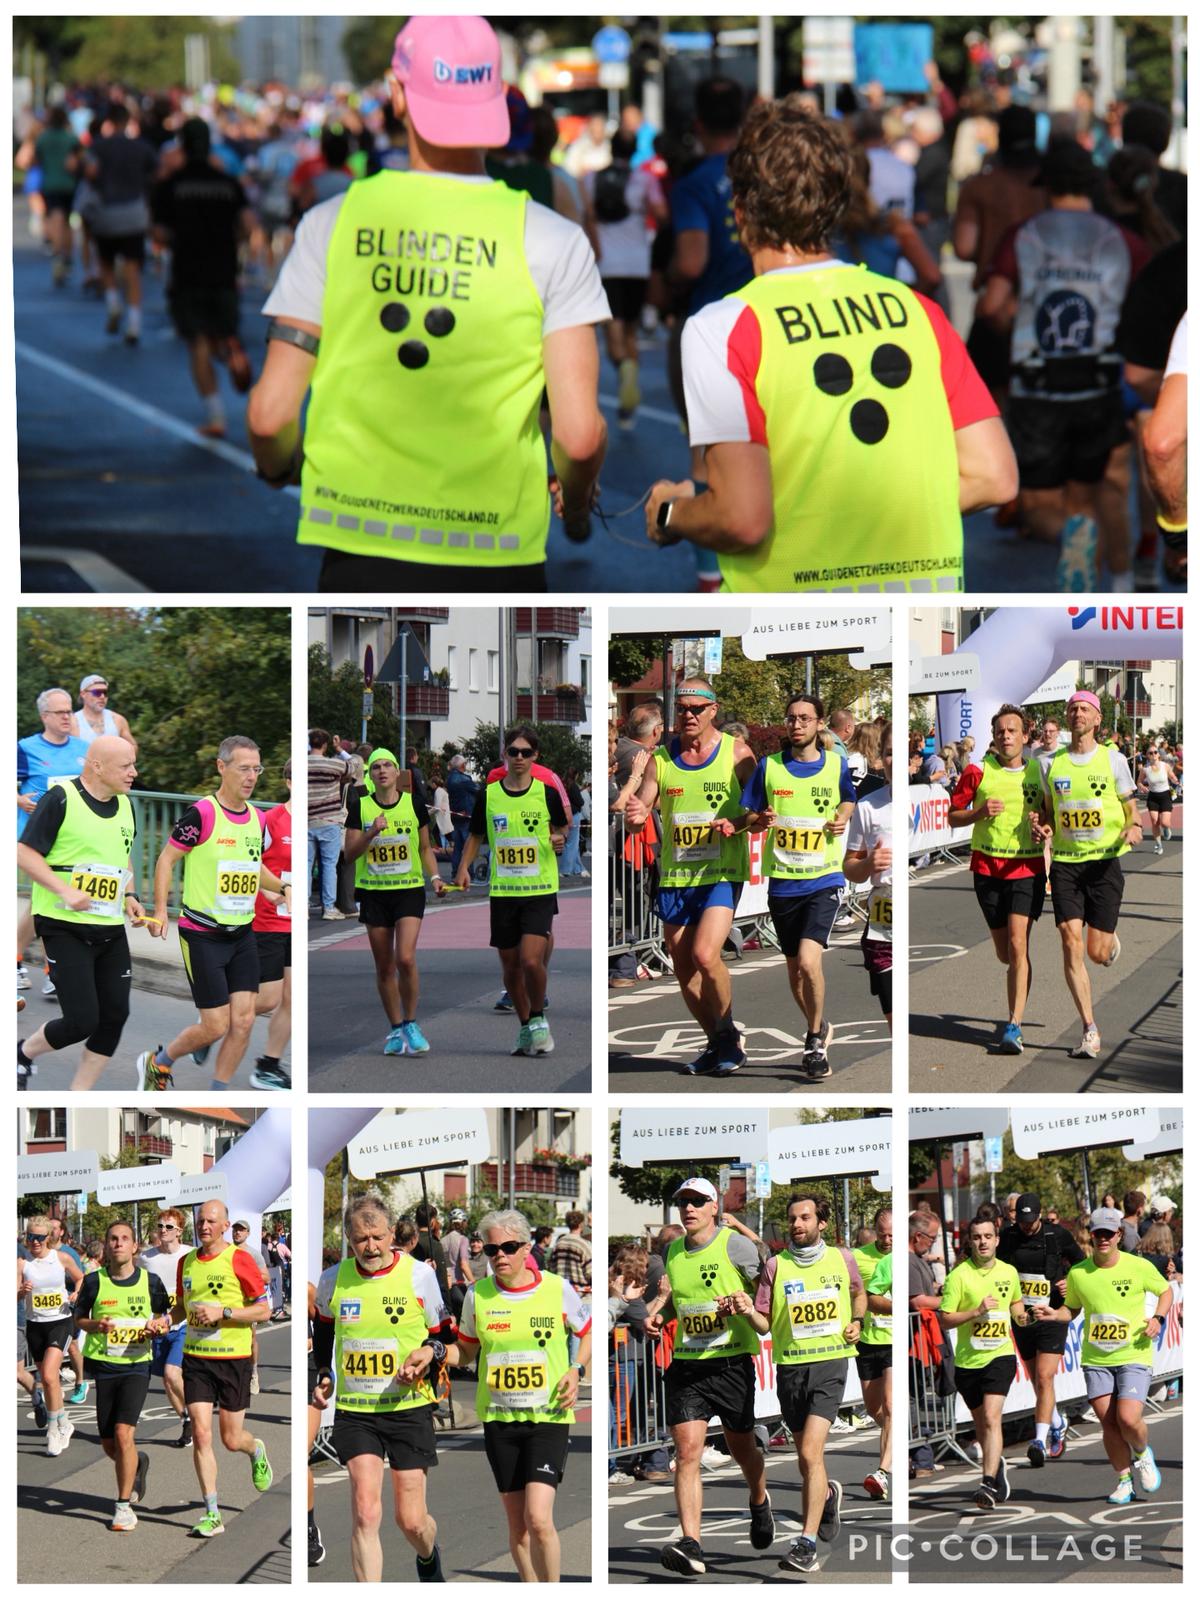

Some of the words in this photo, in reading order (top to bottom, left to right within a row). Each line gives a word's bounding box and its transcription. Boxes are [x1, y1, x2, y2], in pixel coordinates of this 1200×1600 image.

[356, 228, 497, 268] BLINDEN
[371, 263, 472, 301] GUIDE
[775, 292, 908, 345] BLIND
[315, 486, 500, 525] WWW.GUIDENETZWERKDEUTSCHLAND.DE
[753, 625, 774, 634] AUS
[779, 622, 811, 632] LIEBE
[816, 619, 838, 629] ZUM
[843, 616, 878, 626] SPORT
[1101, 607, 1183, 630] INTE
[960, 700, 972, 738] PORT
[704, 782, 726, 792] GUIDE
[811, 787, 832, 797] BLIND
[1062, 811, 1101, 827] 3123
[673, 826, 713, 845] 4077
[777, 829, 822, 850] 3117
[369, 845, 407, 862] 1818
[499, 848, 535, 864] 1819
[75, 874, 117, 900] 1469
[221, 874, 257, 894] 3686
[874, 900, 892, 923] 15
[1024, 1122, 1044, 1132] AUS
[1049, 1118, 1080, 1129] LIEBE
[1086, 1114, 1107, 1124] ZUM
[1112, 1107, 1146, 1119] SPORT
[1160, 1122, 1177, 1131] EBE
[633, 1129, 653, 1138] AUS
[658, 1127, 690, 1137] LIEBE
[695, 1126, 717, 1135] ZUM
[722, 1124, 757, 1134] SPORT
[360, 1145, 379, 1154] AUS
[383, 1140, 414, 1151] LIEBE
[418, 1137, 440, 1146] ZUM
[444, 1131, 477, 1142] SPORT
[778, 1151, 797, 1160] AUS
[802, 1149, 830, 1158] LIEBE
[835, 1146, 855, 1155] ZUM
[859, 1142, 891, 1152] SPORT
[34, 1294, 61, 1307] 3485
[128, 1296, 145, 1304] BLIND
[382, 1297, 407, 1305] BLIND
[793, 1301, 837, 1324] 2882
[530, 1317, 555, 1329] GUIDE
[683, 1315, 724, 1334] 2604
[973, 1323, 1006, 1337] 2224
[1092, 1325, 1127, 1340] 4225
[345, 1354, 394, 1375] 4419
[492, 1366, 543, 1389] 1655
